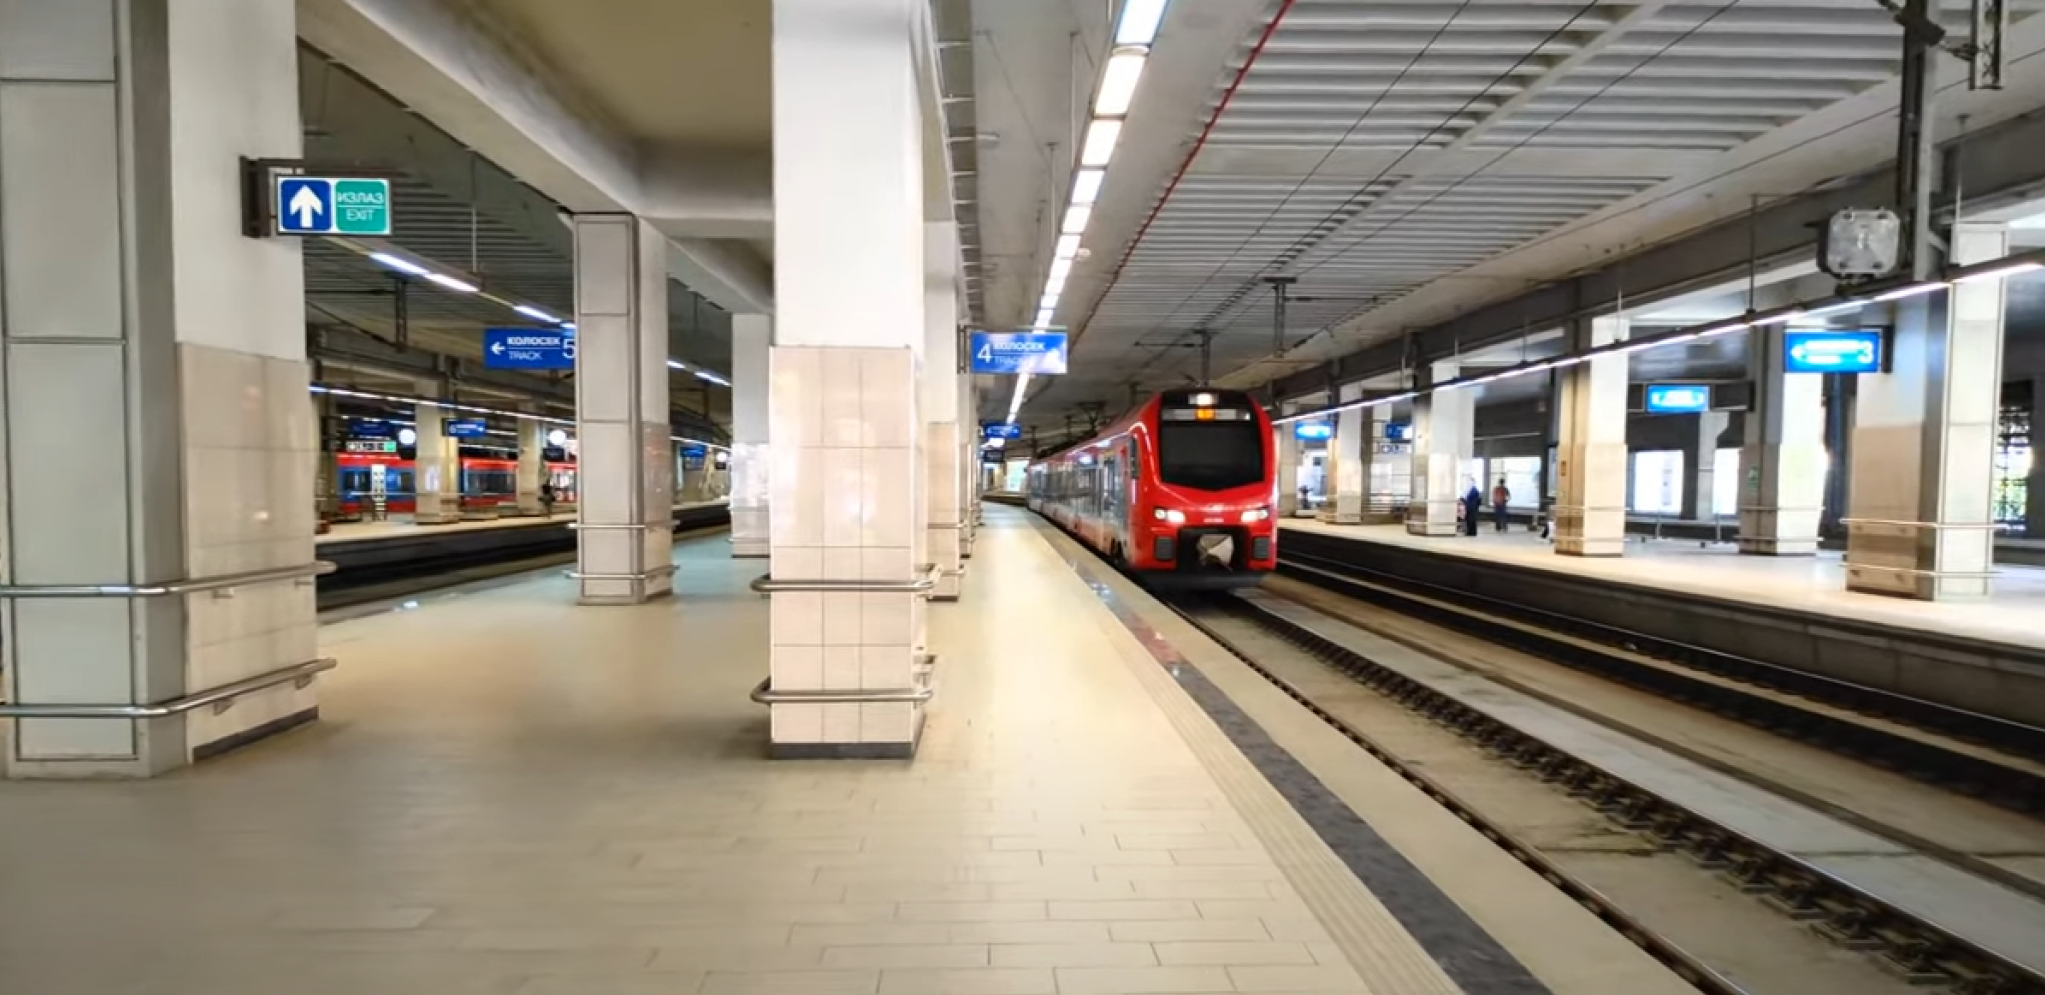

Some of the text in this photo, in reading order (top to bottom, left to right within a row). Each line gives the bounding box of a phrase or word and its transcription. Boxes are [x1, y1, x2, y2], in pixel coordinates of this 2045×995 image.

[338, 192, 383, 204] ИЗЛАЗ
[346, 208, 375, 221] EXIT
[507, 336, 561, 346] КОЛОСЕК
[562, 338, 575, 359] 5
[977, 343, 993, 363] 4
[1857, 340, 1874, 364] 3
[508, 350, 544, 361] TRACK
